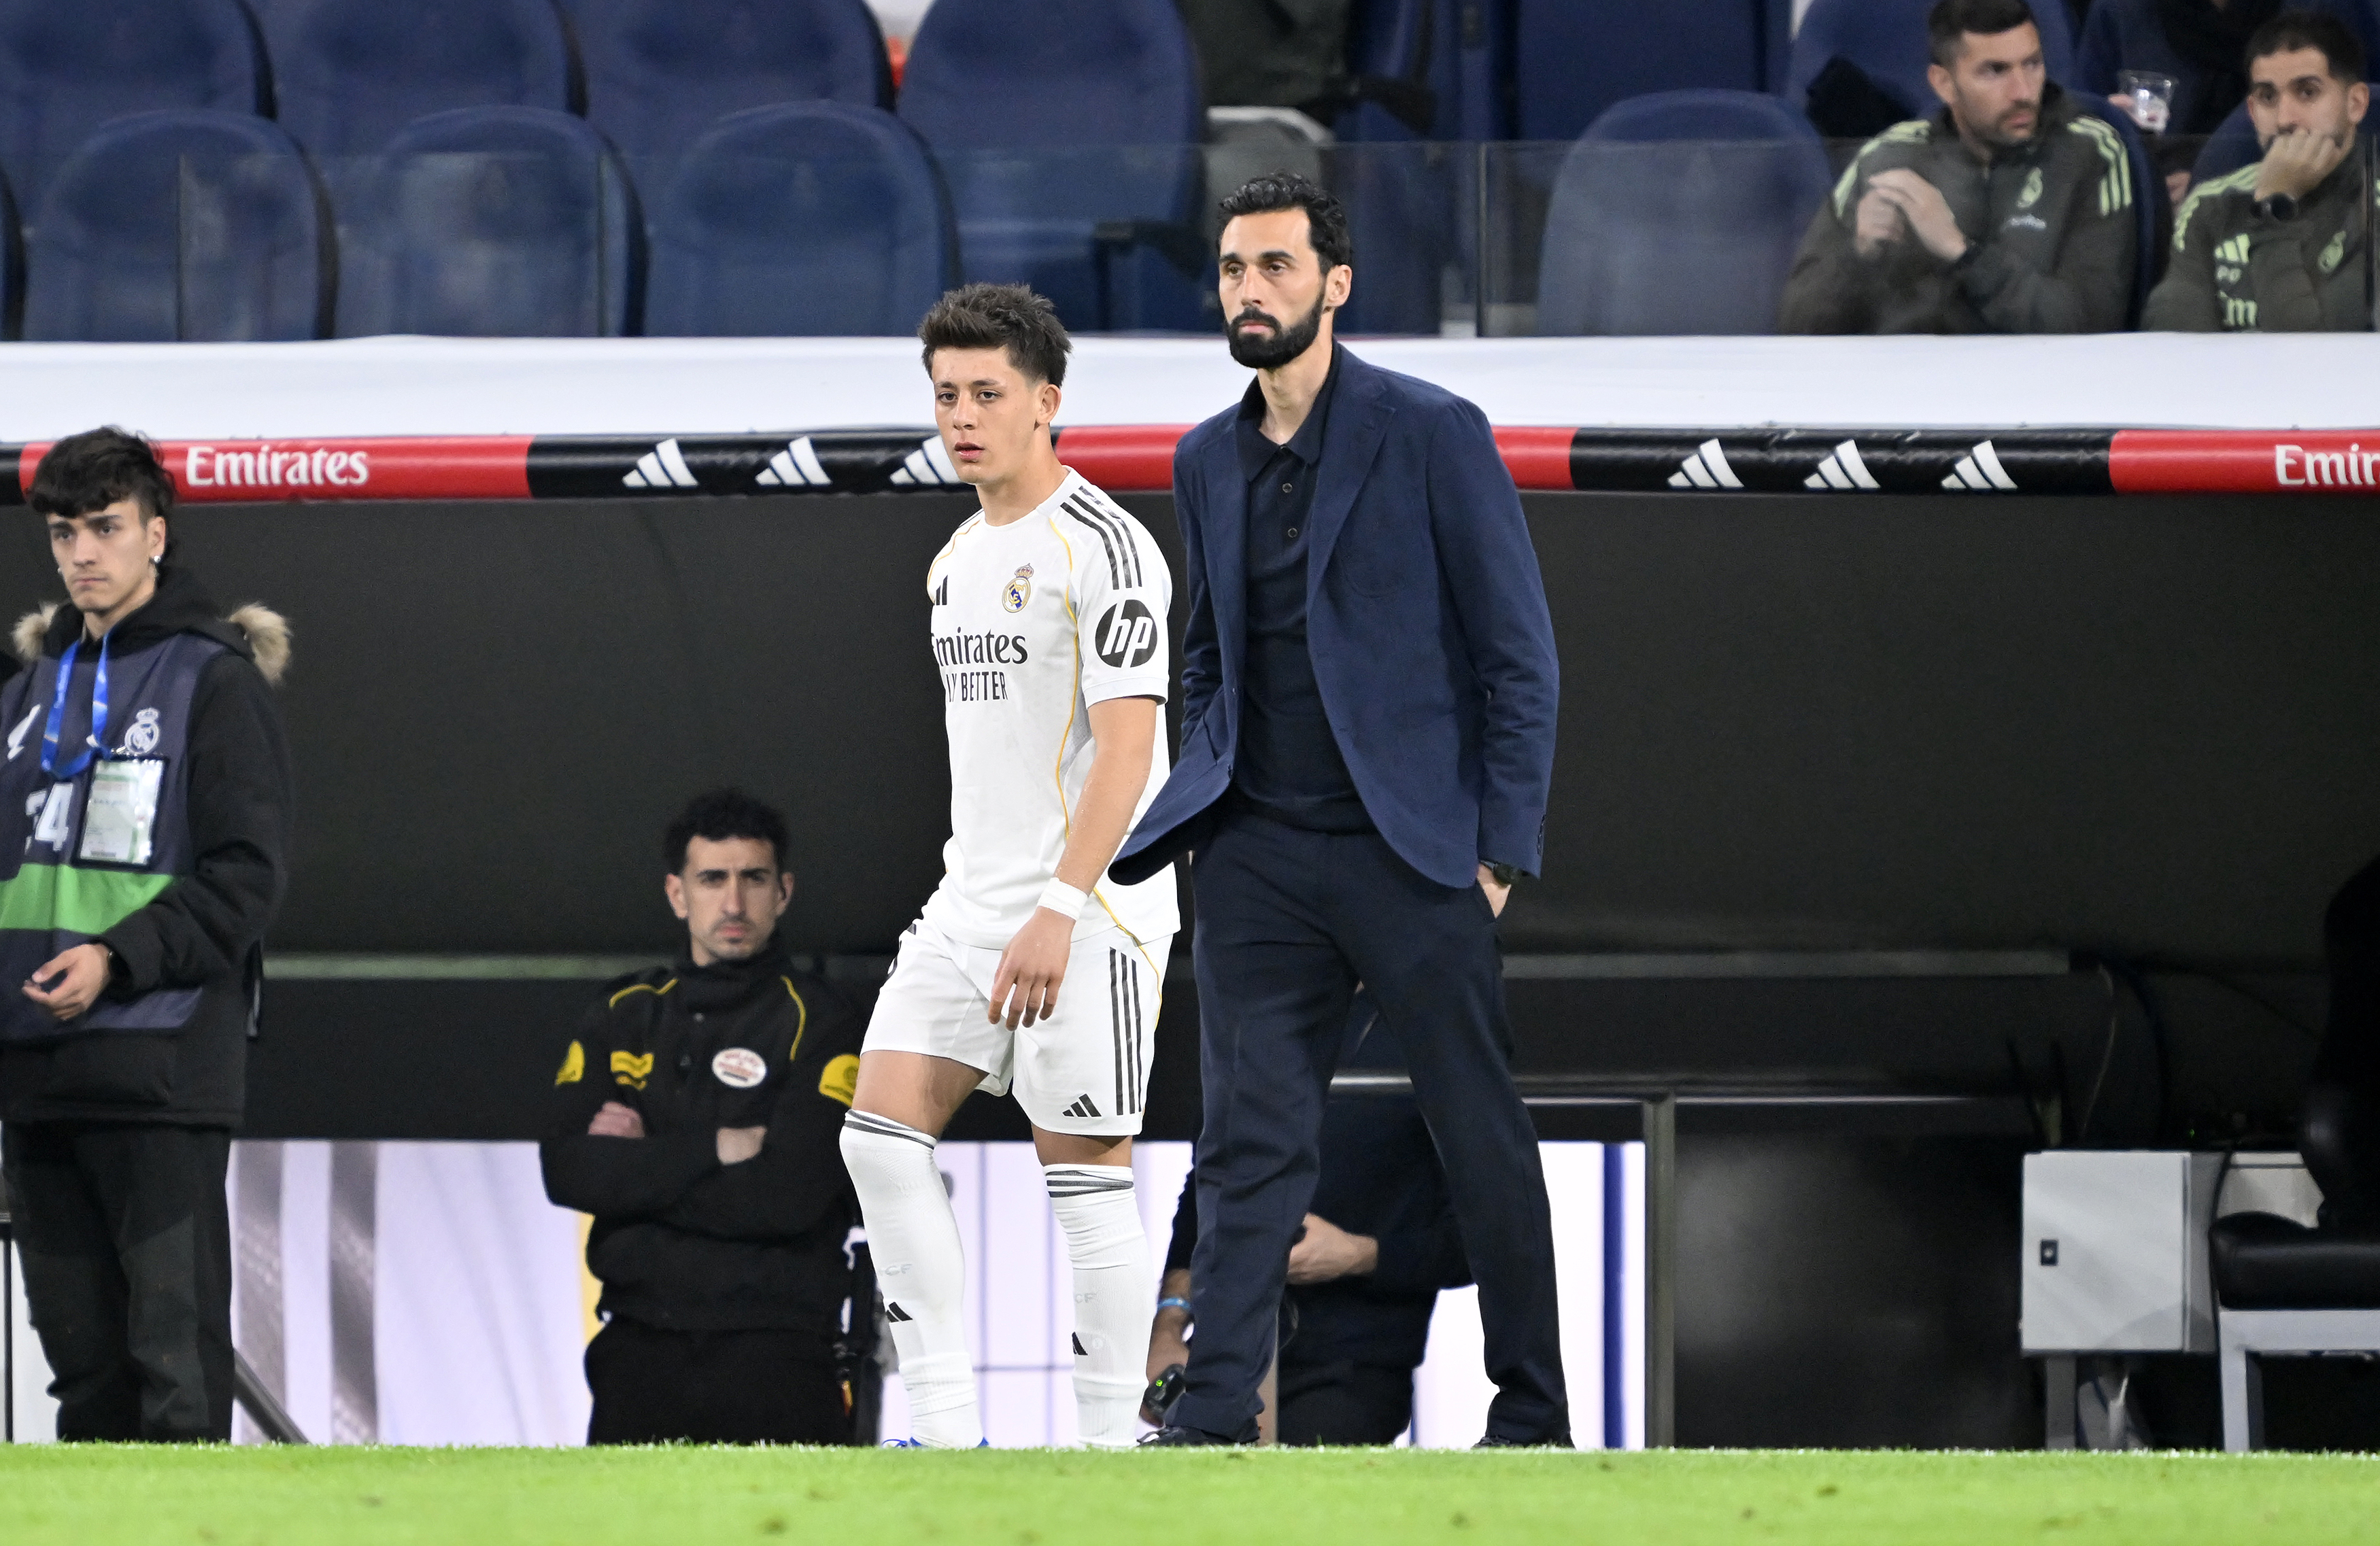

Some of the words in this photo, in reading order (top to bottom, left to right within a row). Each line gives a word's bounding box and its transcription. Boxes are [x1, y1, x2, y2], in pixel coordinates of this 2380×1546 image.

[2219, 290, 2257, 326] m
[186, 445, 368, 486] Emirates
[2276, 443, 2380, 485] Emir
[932, 626, 1028, 667] mirates
[1101, 600, 1154, 668] hp
[961, 671, 1008, 702] BETTER
